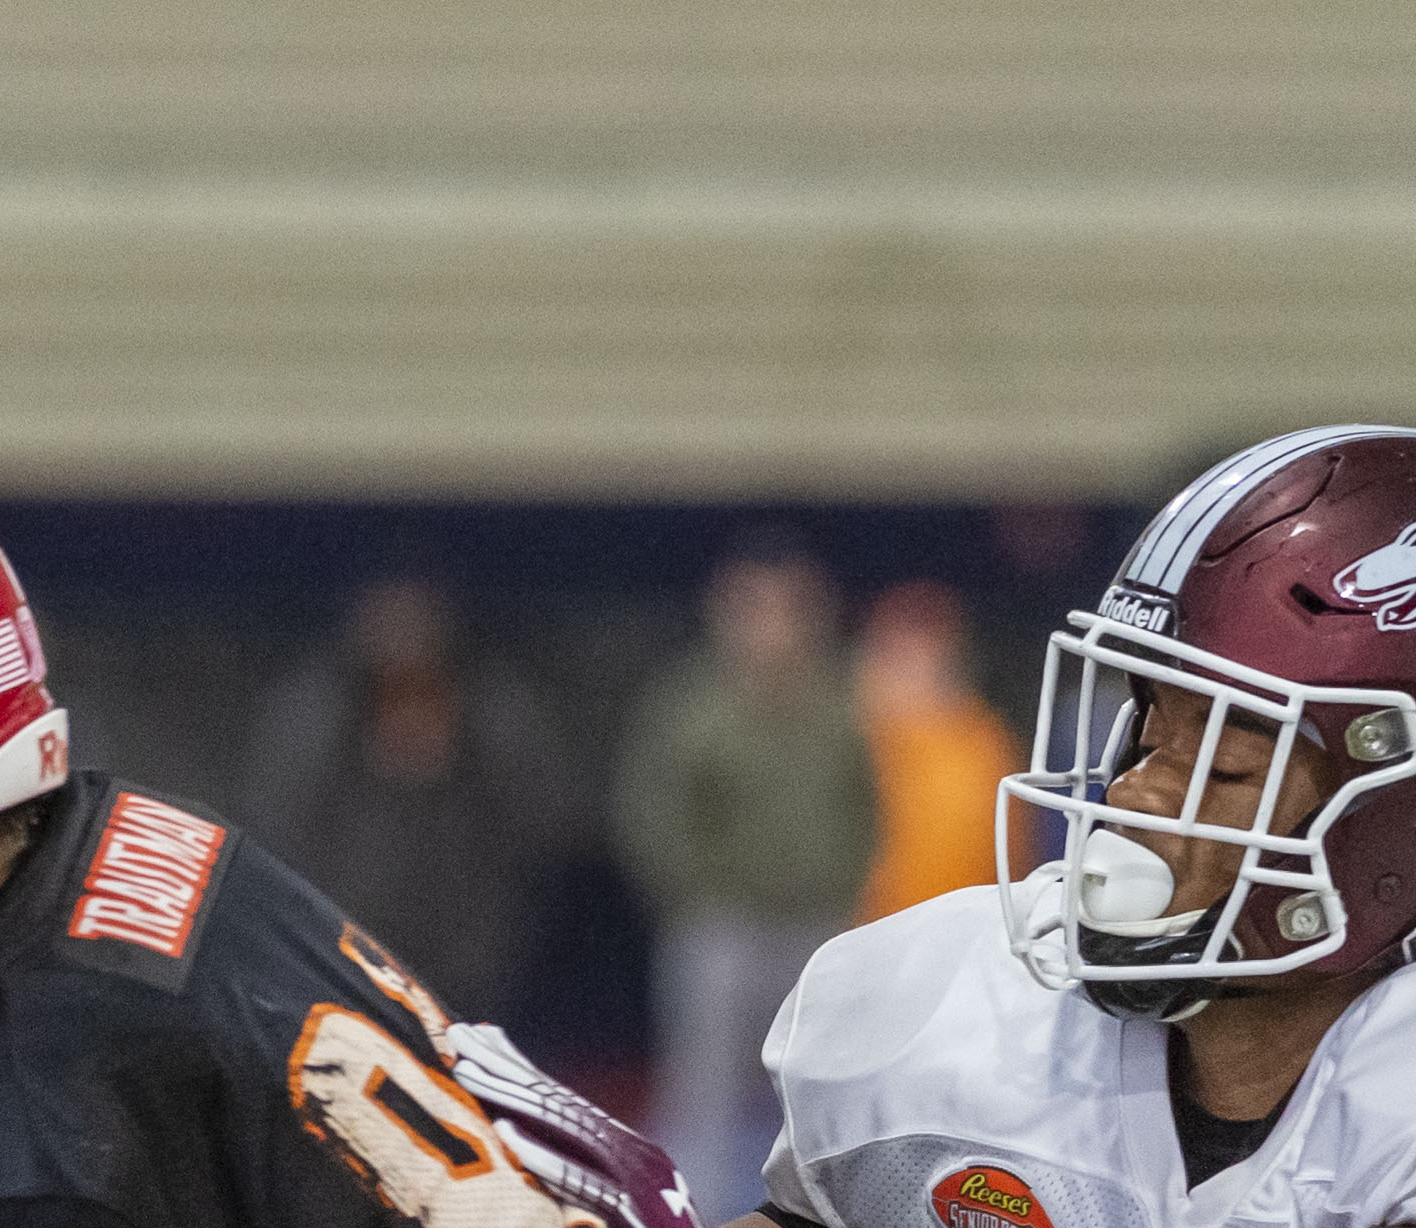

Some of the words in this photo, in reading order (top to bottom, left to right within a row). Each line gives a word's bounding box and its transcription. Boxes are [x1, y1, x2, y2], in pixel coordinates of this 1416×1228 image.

[1096, 589, 1171, 633] Riddell
[70, 793, 224, 956] TRAUTMAN
[960, 1173, 1032, 1217] Reese's
